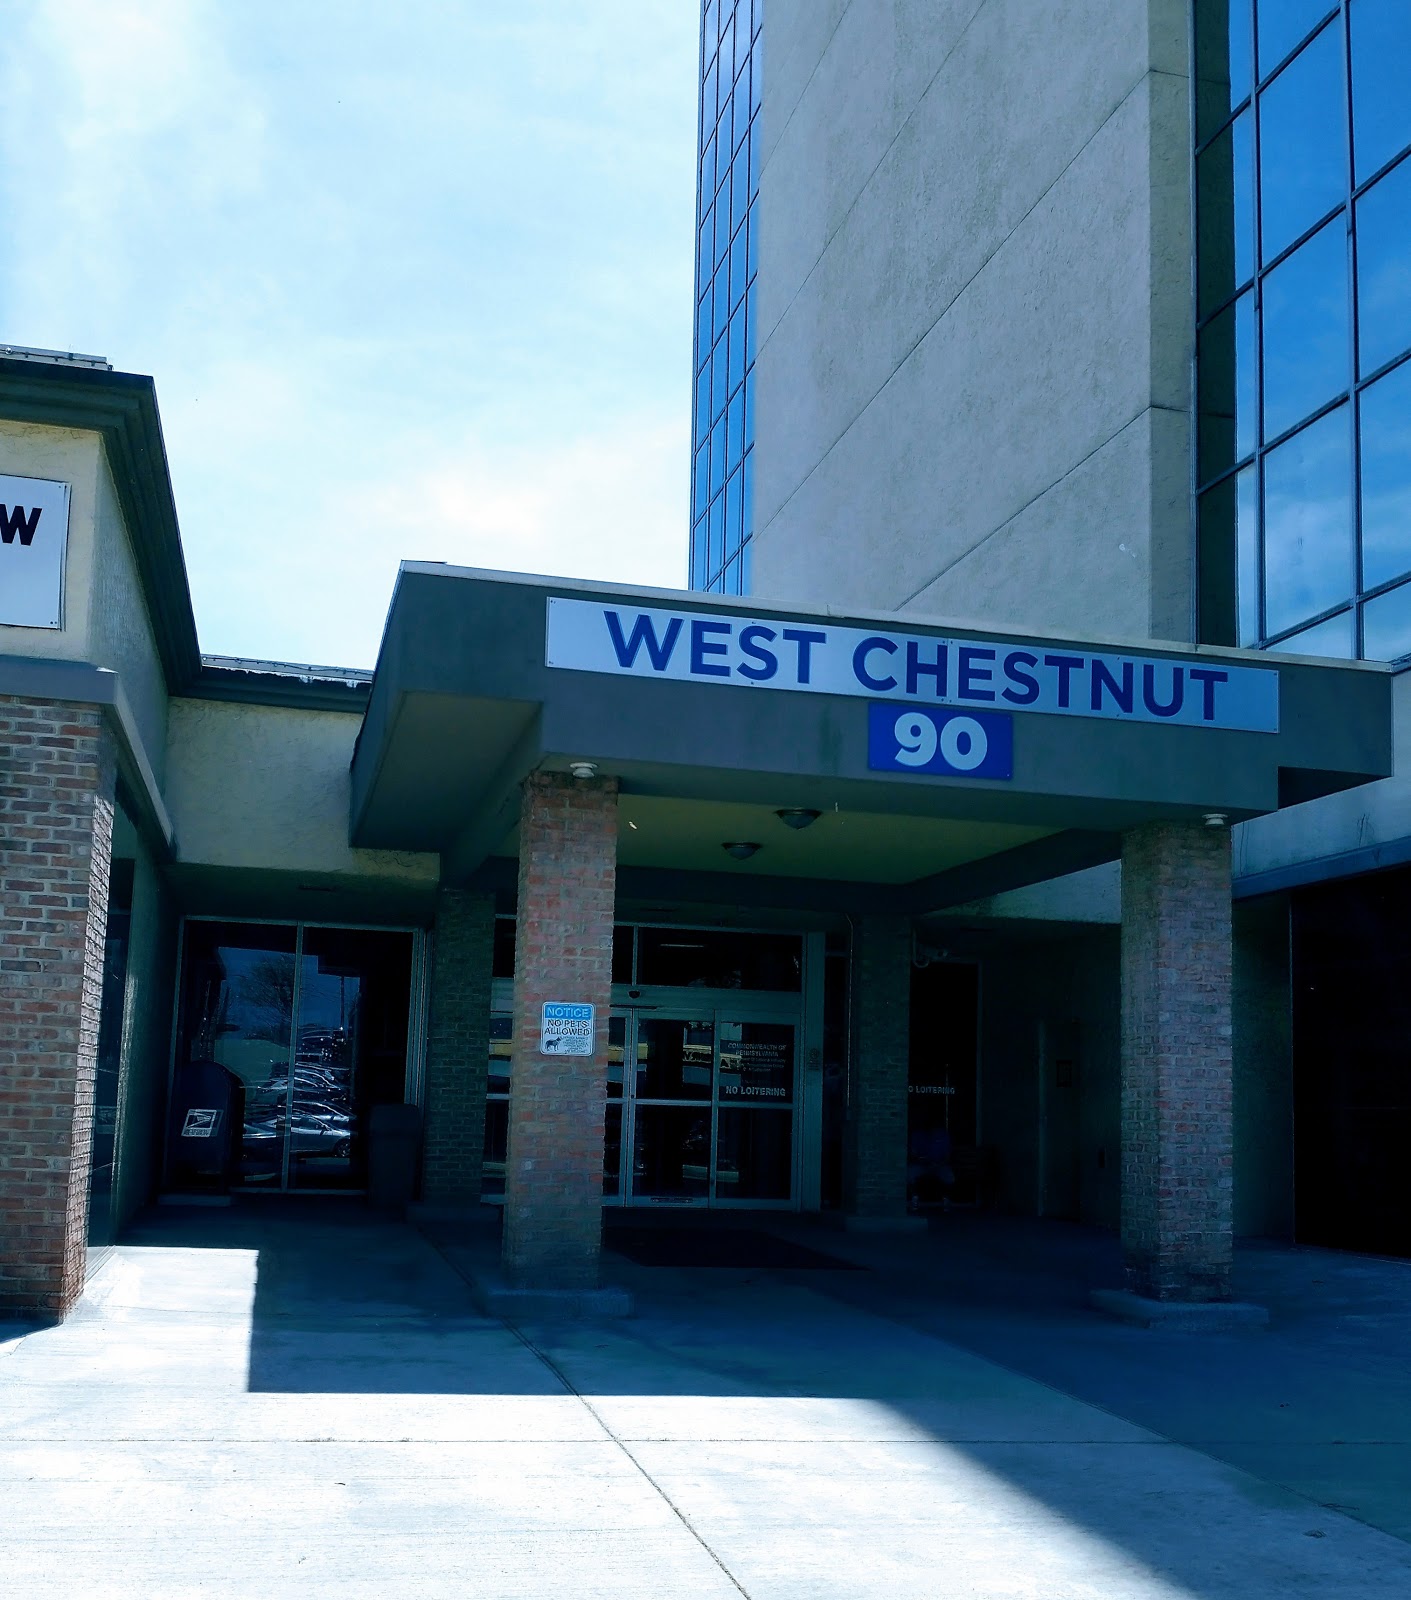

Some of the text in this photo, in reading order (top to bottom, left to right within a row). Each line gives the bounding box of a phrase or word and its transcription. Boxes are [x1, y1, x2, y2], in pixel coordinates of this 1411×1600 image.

[603, 610, 1228, 720] WEST CHESTNUT
[894, 712, 988, 770] 90
[547, 1007, 589, 1018] NOTICE
[547, 1019, 589, 1028] NO PETS
[544, 1027, 591, 1036] ALLOWED
[725, 1086, 786, 1097] NO LOITERING
[915, 1086, 955, 1095] LOITERING
